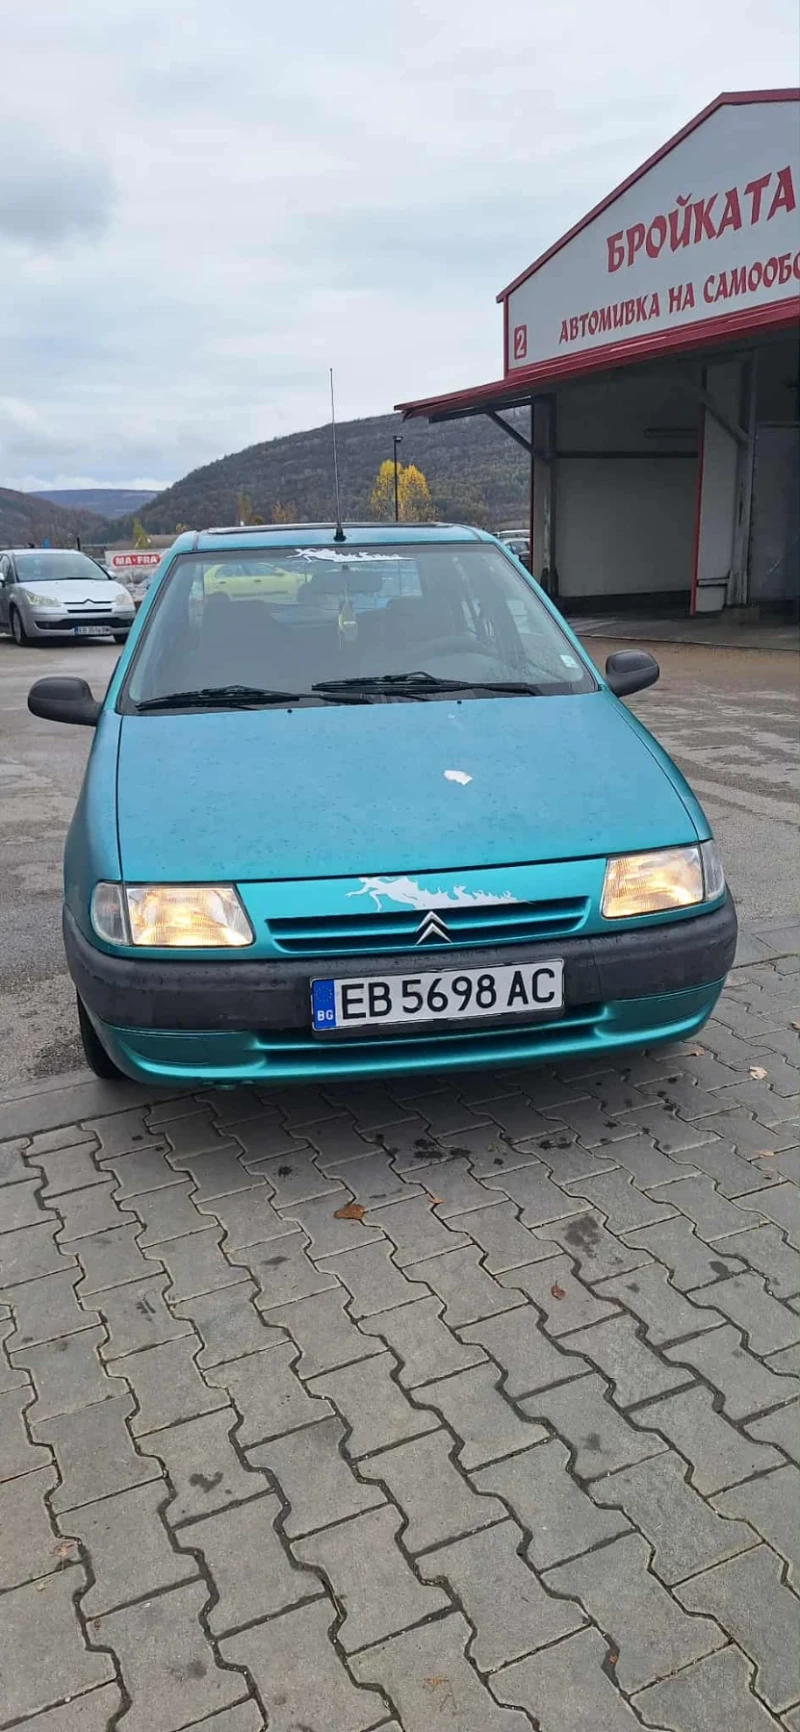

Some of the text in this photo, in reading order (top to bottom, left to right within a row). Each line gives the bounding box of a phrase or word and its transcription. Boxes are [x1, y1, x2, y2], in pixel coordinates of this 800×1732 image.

[606, 165, 796, 273] БРОЙКАТА
[559, 292, 660, 344] АВТОМИВКА
[668, 282, 695, 314] НА
[515, 328, 526, 357] 2
[317, 1010, 334, 1021] BG
[341, 968, 555, 1020] EB 5698 AC
